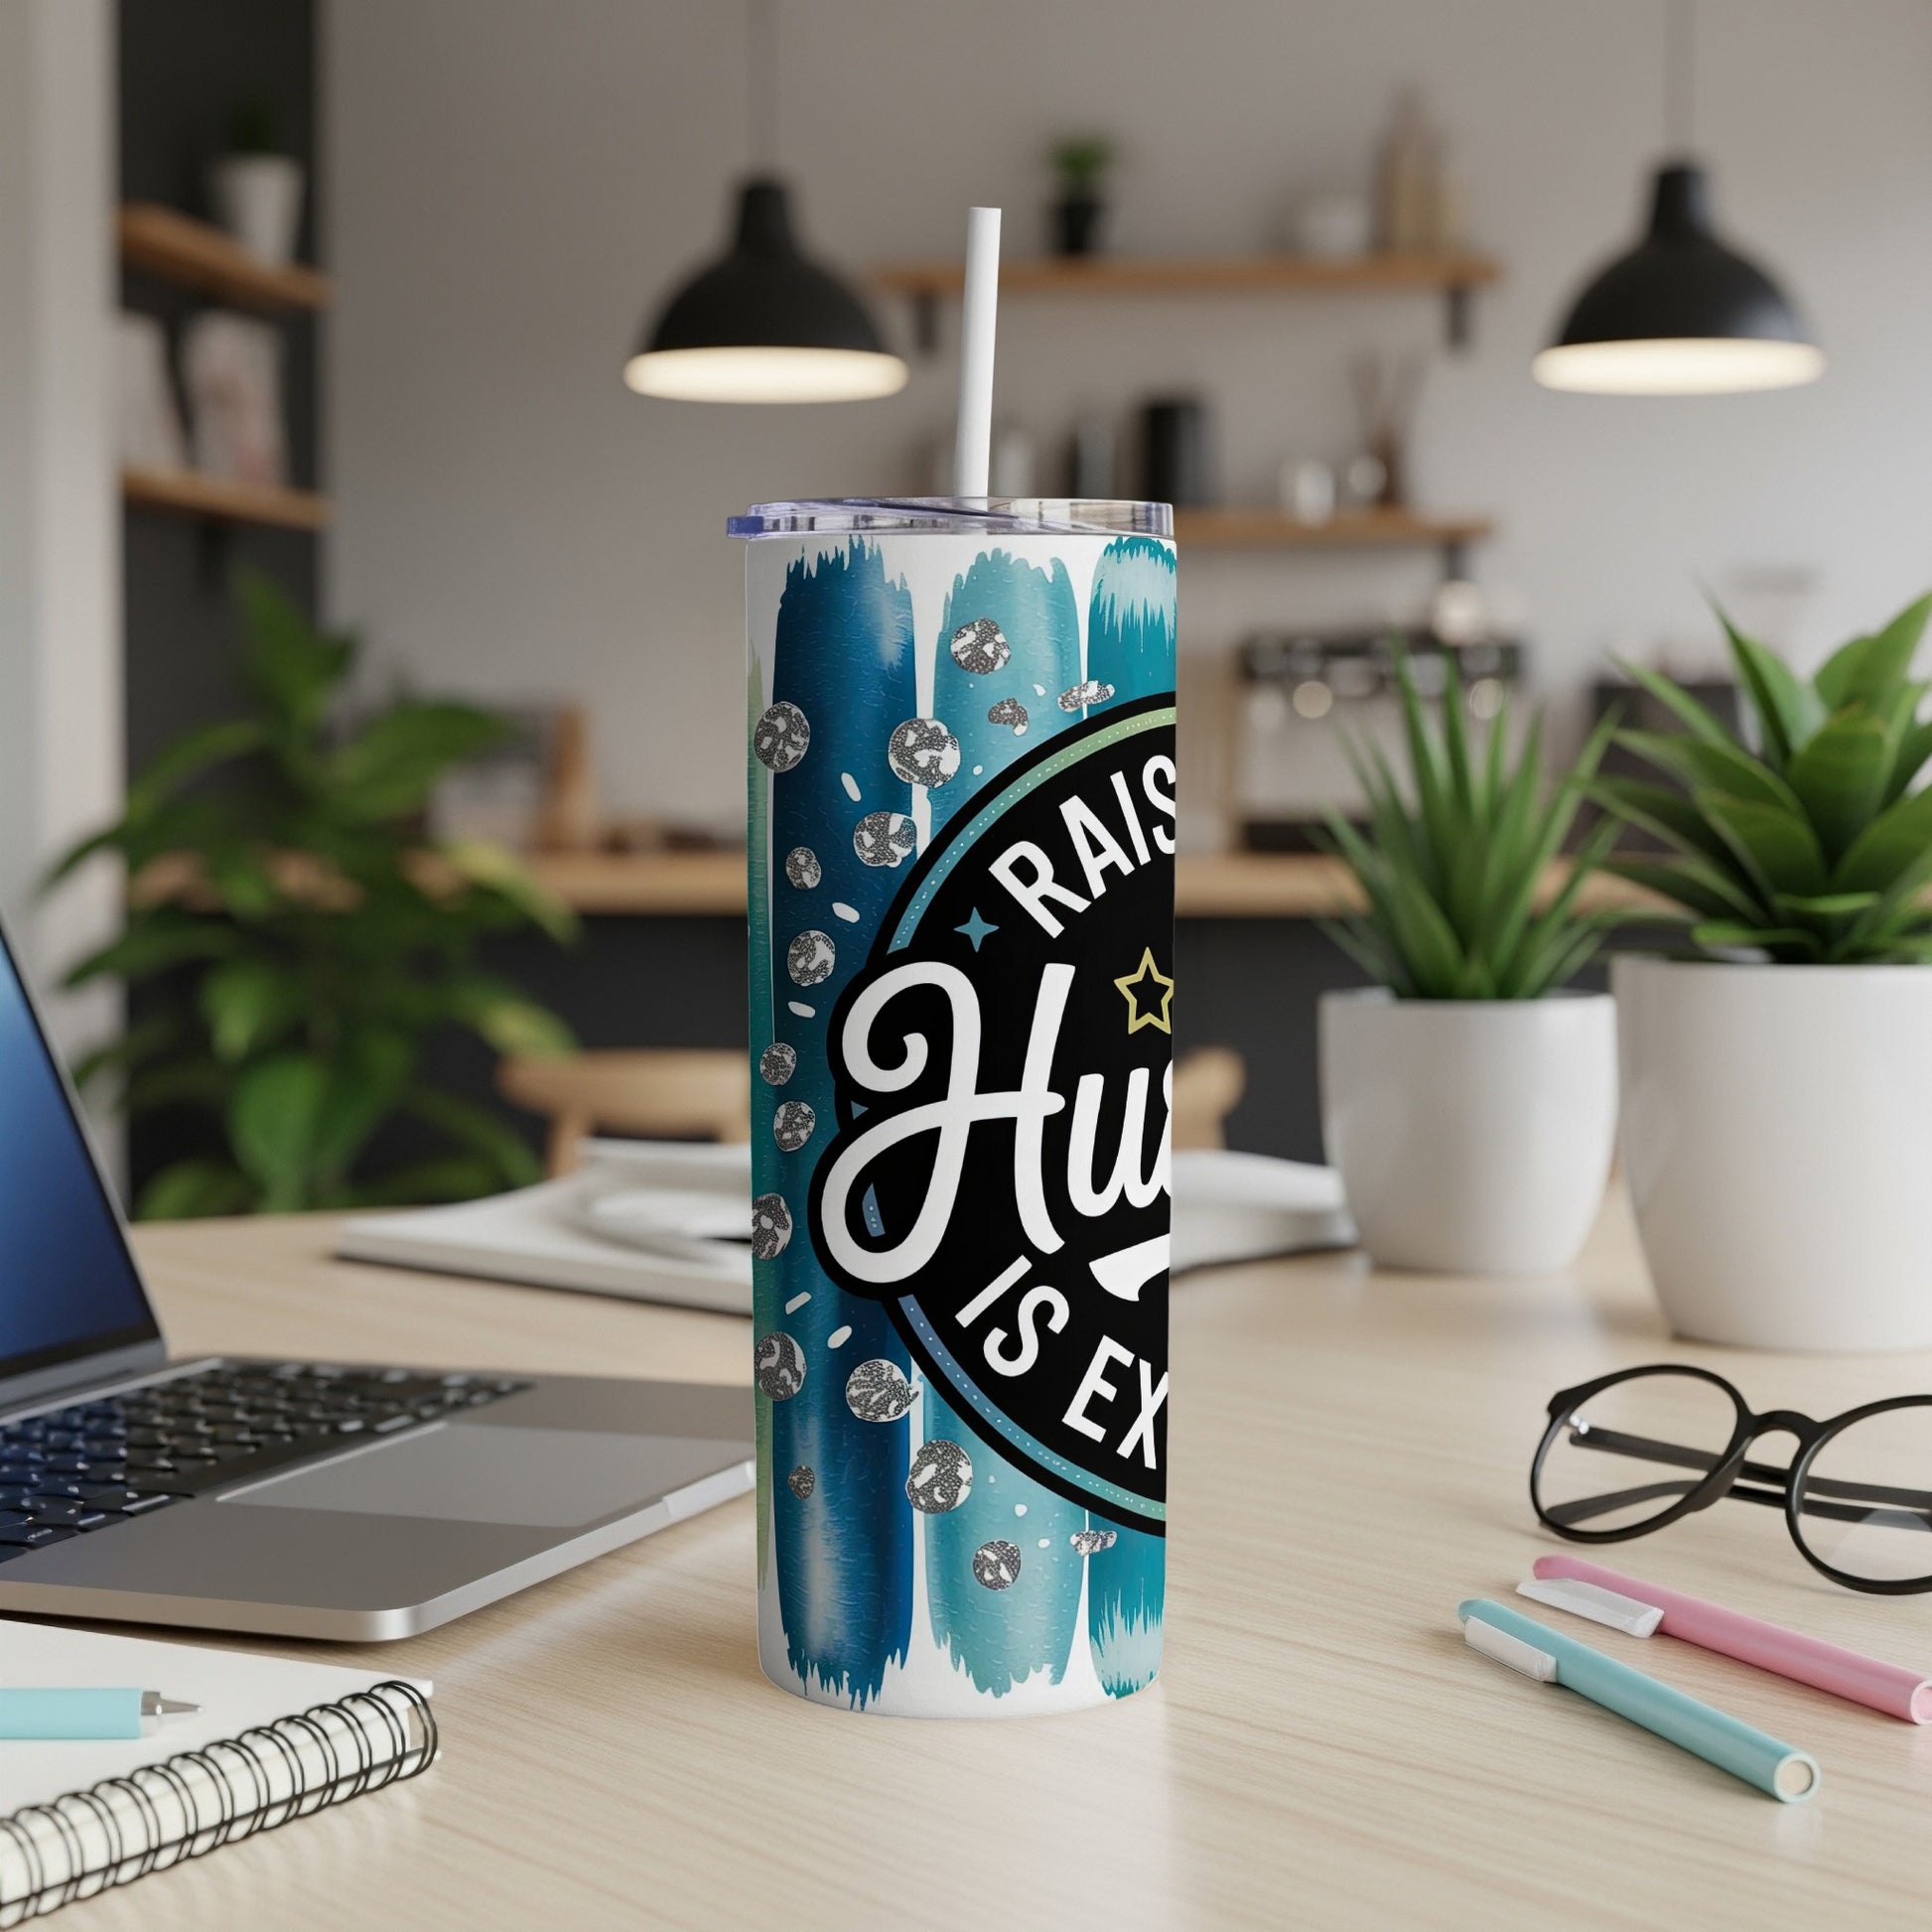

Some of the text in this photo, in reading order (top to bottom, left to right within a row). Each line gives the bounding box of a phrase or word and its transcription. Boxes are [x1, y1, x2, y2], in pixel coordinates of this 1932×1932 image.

[821, 961, 1173, 1284] Hu
[954, 1254, 1169, 1470] IS EX
